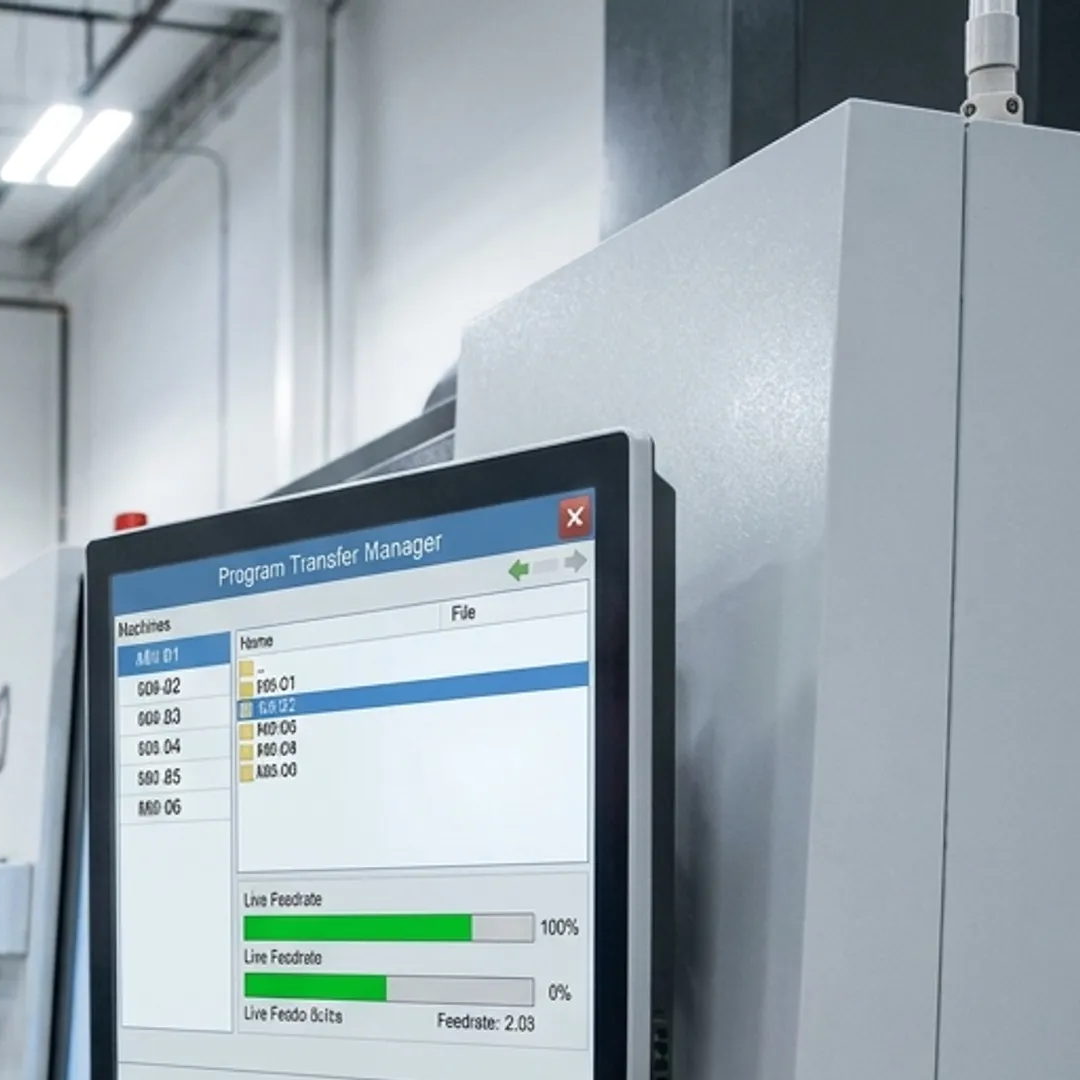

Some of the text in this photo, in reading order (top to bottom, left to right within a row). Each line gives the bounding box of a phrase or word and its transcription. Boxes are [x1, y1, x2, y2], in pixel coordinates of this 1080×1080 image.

[219, 534, 443, 587] Program Transfer Manager
[541, 918, 579, 936] 100%
[548, 983, 572, 1001] 0%
[505, 1014, 535, 1032] 2.03
